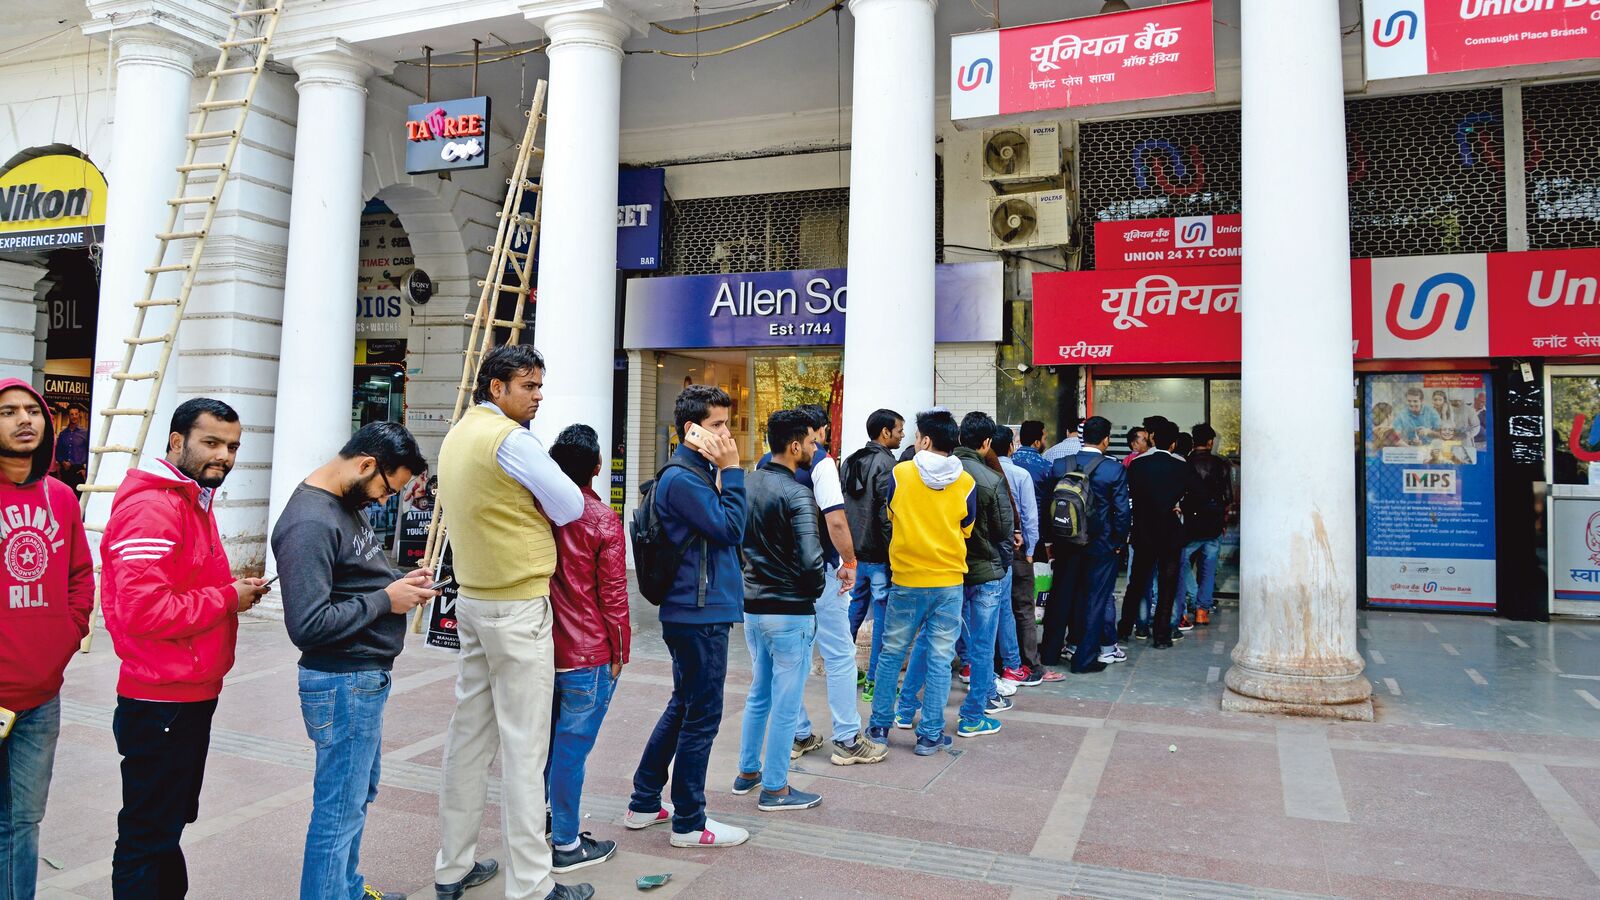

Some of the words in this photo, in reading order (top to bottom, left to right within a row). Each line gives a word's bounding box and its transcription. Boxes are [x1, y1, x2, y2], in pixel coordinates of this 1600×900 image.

[1464, 34, 1519, 46] Connaught
[1520, 31, 1549, 41] Place
[1550, 27, 1588, 37] Branch
[1030, 34, 1129, 73] यूनियन
[1134, 22, 1182, 51] बैंक
[1122, 56, 1147, 68] ऑफ
[1149, 52, 1181, 66] इंडिया
[1061, 75, 1083, 88] प्लेस
[1088, 72, 1115, 83] शाखा
[0, 183, 88, 222] Nikon
[0, 232, 55, 249] EXPERIENCE
[56, 232, 84, 246] ZONE
[361, 258, 390, 267] TIMEX
[640, 257, 655, 265] BAR
[1124, 250, 1164, 262] UNION
[1167, 249, 1183, 260] 24
[1185, 249, 1195, 259] X
[1198, 249, 1206, 258] 7
[1526, 268, 1600, 308] Un
[709, 282, 797, 317] Allen
[1101, 274, 1242, 331] यूनियन
[769, 324, 794, 335] Est
[799, 322, 832, 335] 1744
[1058, 341, 1114, 358] एटीएम
[1531, 334, 1568, 349] कनॉट
[45, 379, 90, 394] CANTABIL
[1405, 472, 1451, 488] IMPS
